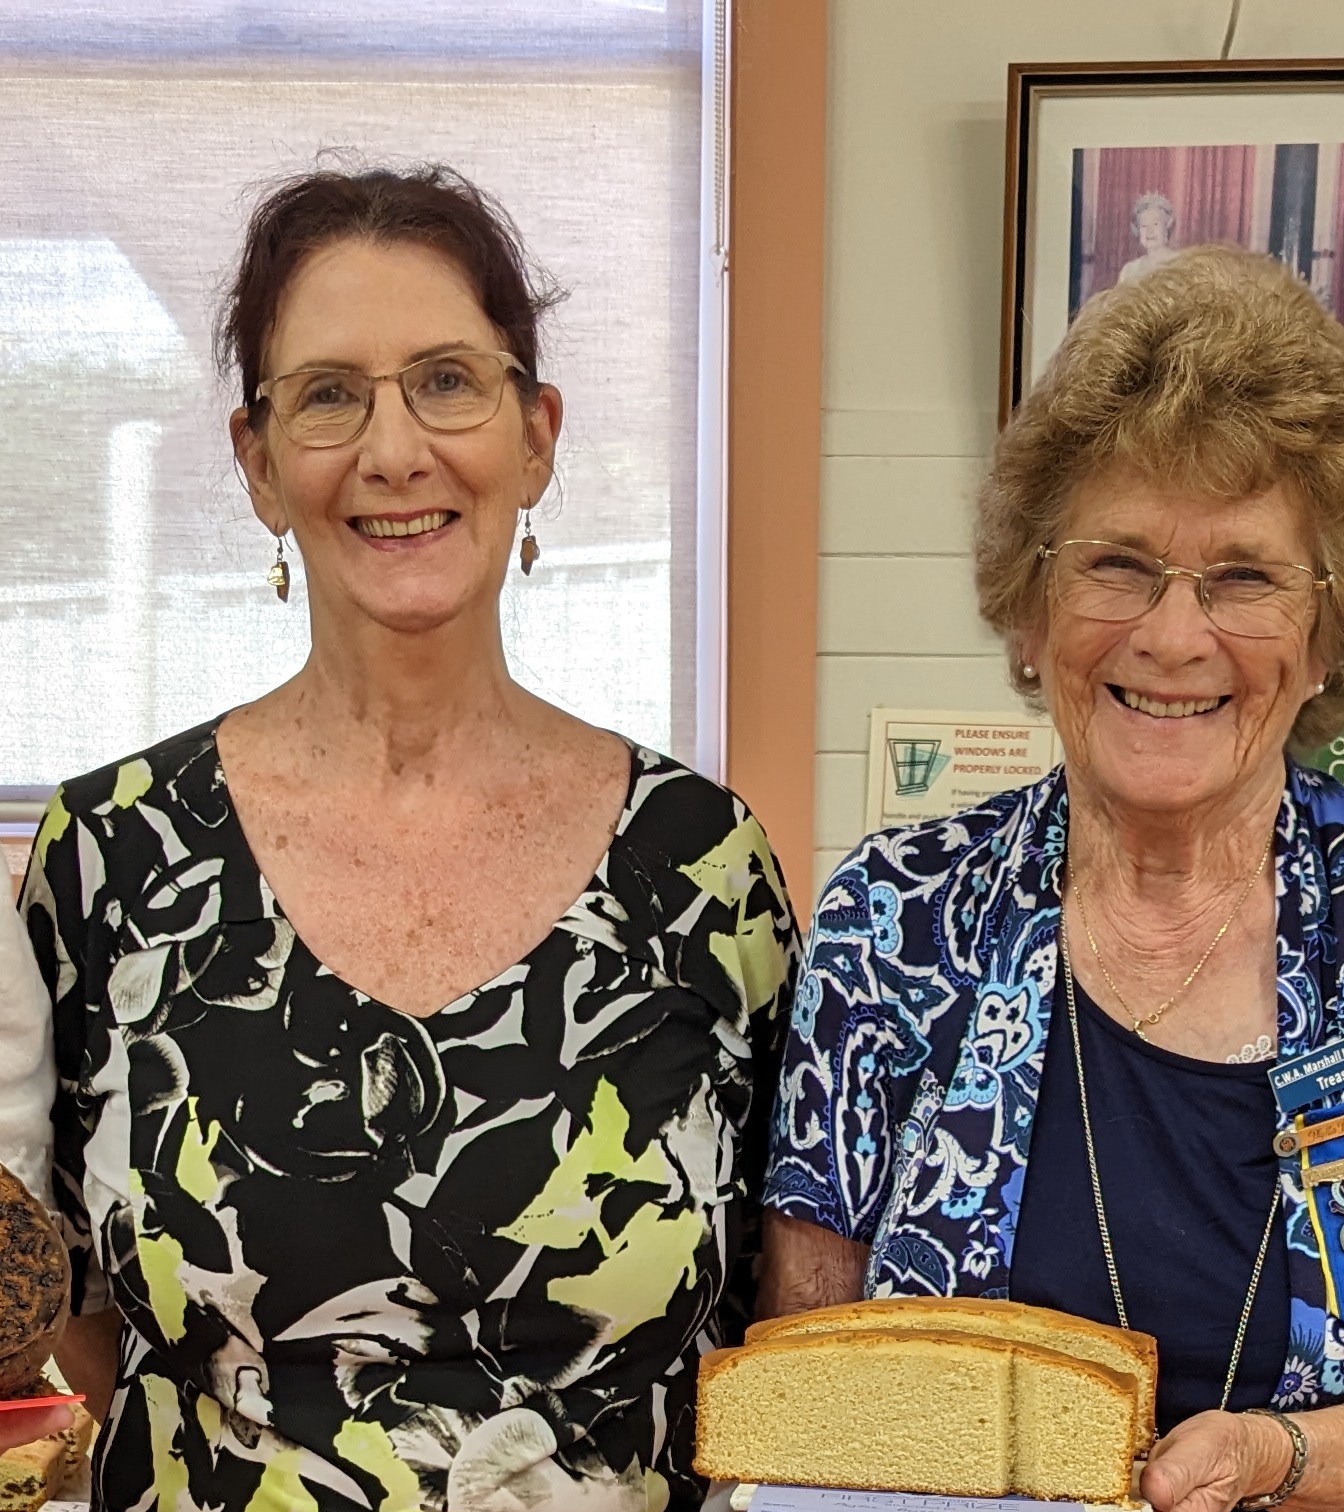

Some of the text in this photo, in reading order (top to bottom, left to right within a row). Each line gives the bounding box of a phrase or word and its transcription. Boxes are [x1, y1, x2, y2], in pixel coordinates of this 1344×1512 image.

[954, 729, 1030, 740] PLEASE ENSURE
[954, 747, 1028, 757] WINDOWS ARE
[952, 764, 1001, 774] PROPERLY
[1274, 1068, 1304, 1087] C.W.A.
[1303, 1048, 1342, 1074] Marshall
